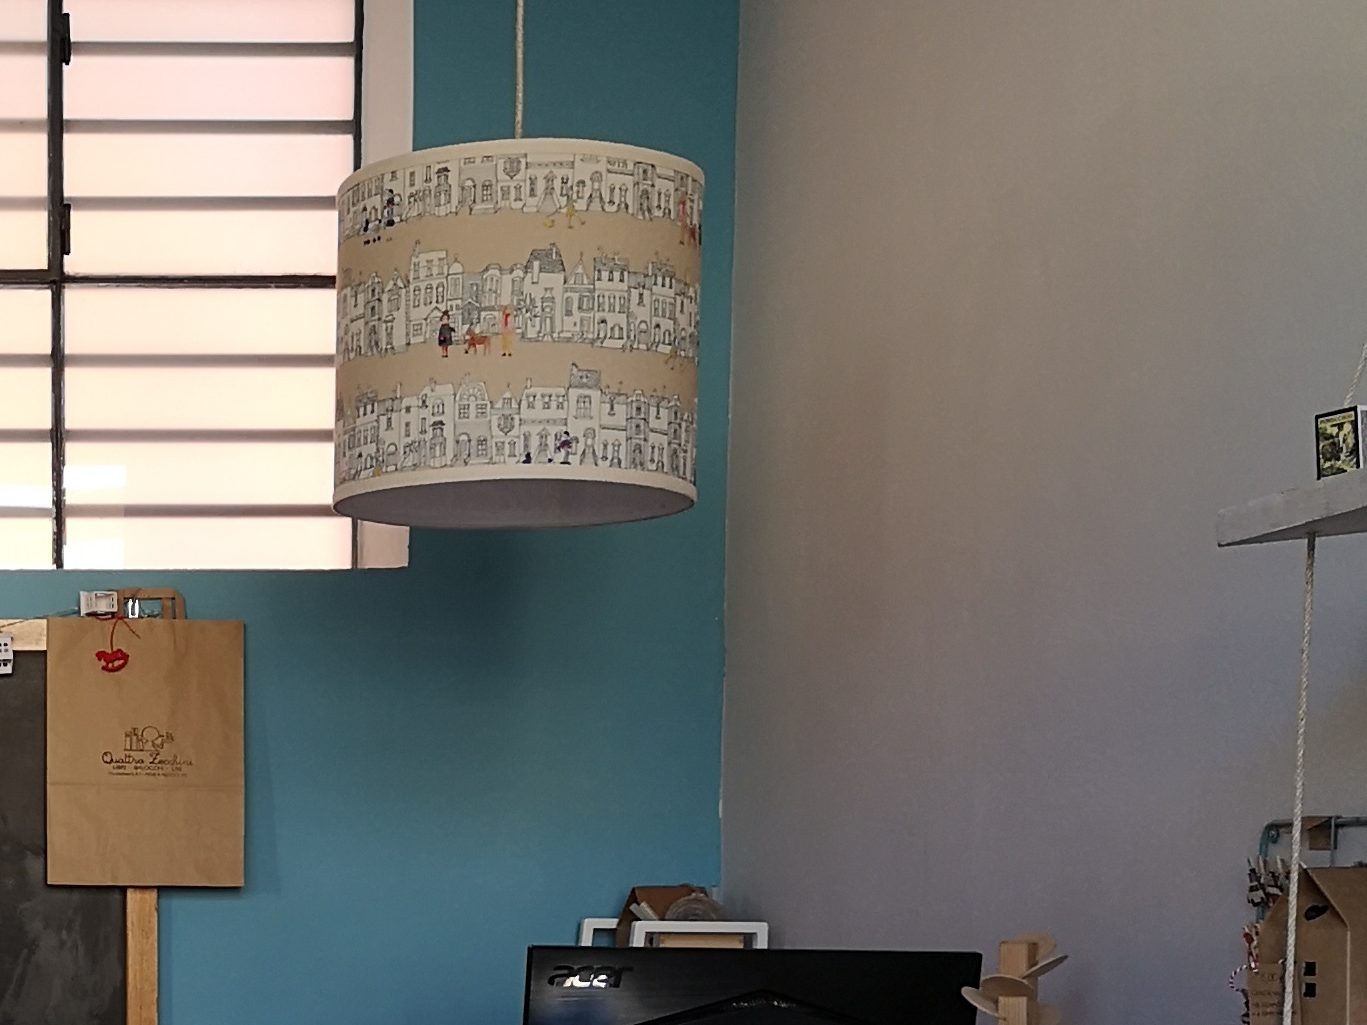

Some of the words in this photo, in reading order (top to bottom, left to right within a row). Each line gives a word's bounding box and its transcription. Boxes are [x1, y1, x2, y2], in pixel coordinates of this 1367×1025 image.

[102, 751, 144, 765] Quattro
[149, 752, 193, 766] Zecchini
[547, 965, 634, 988] acer
